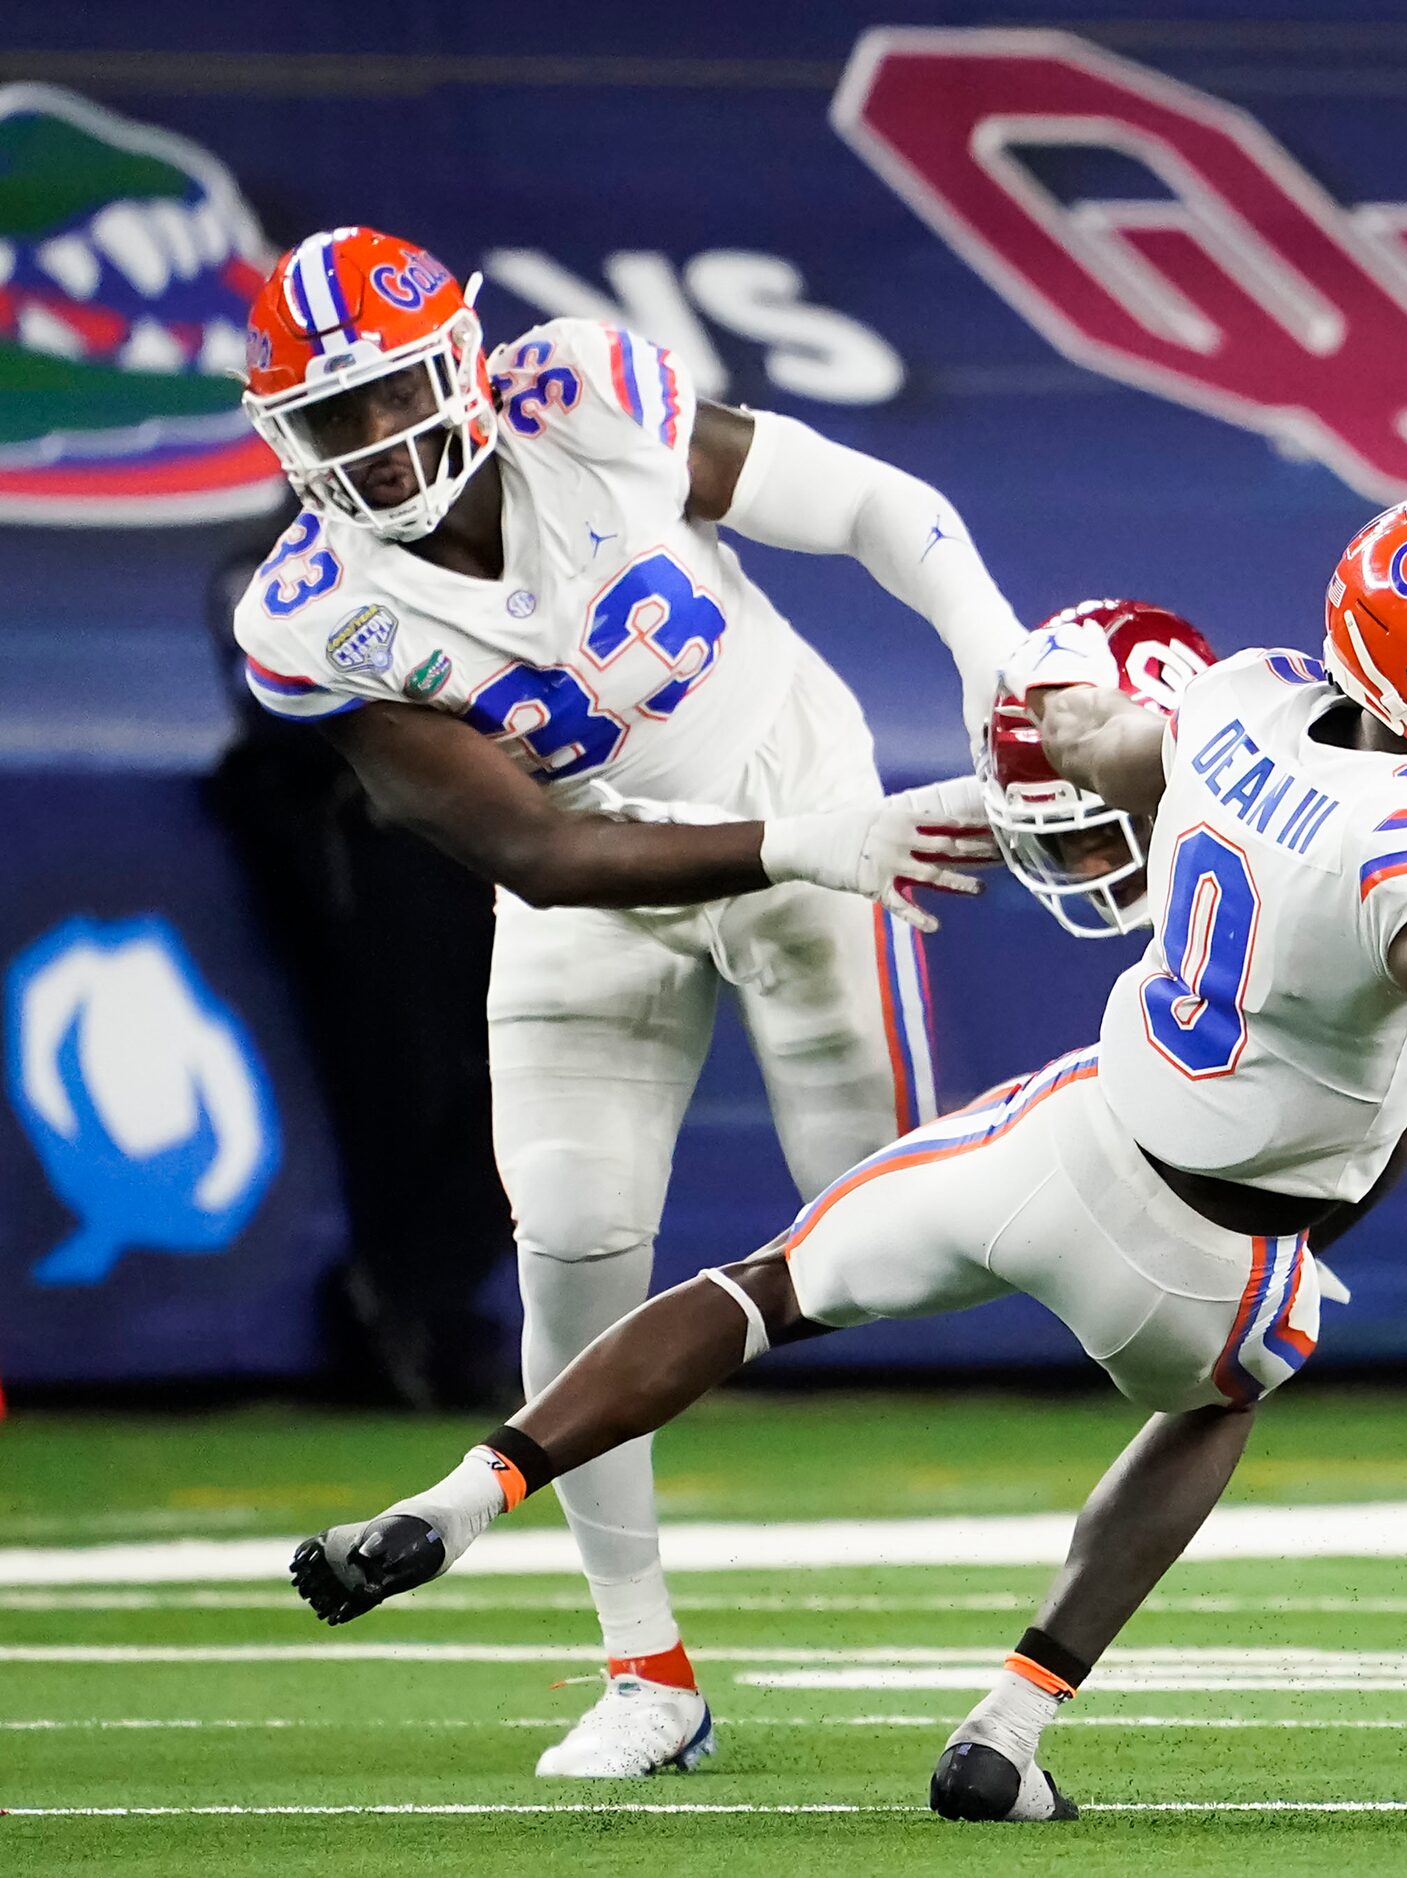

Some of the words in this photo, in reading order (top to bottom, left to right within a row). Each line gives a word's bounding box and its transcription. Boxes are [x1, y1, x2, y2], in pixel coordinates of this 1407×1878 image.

[484, 247, 904, 404] VS
[259, 511, 344, 619] 33
[455, 544, 728, 784] 33
[1191, 718, 1296, 834] DEAN
[1276, 787, 1340, 855] III
[1139, 821, 1262, 1082] 0
